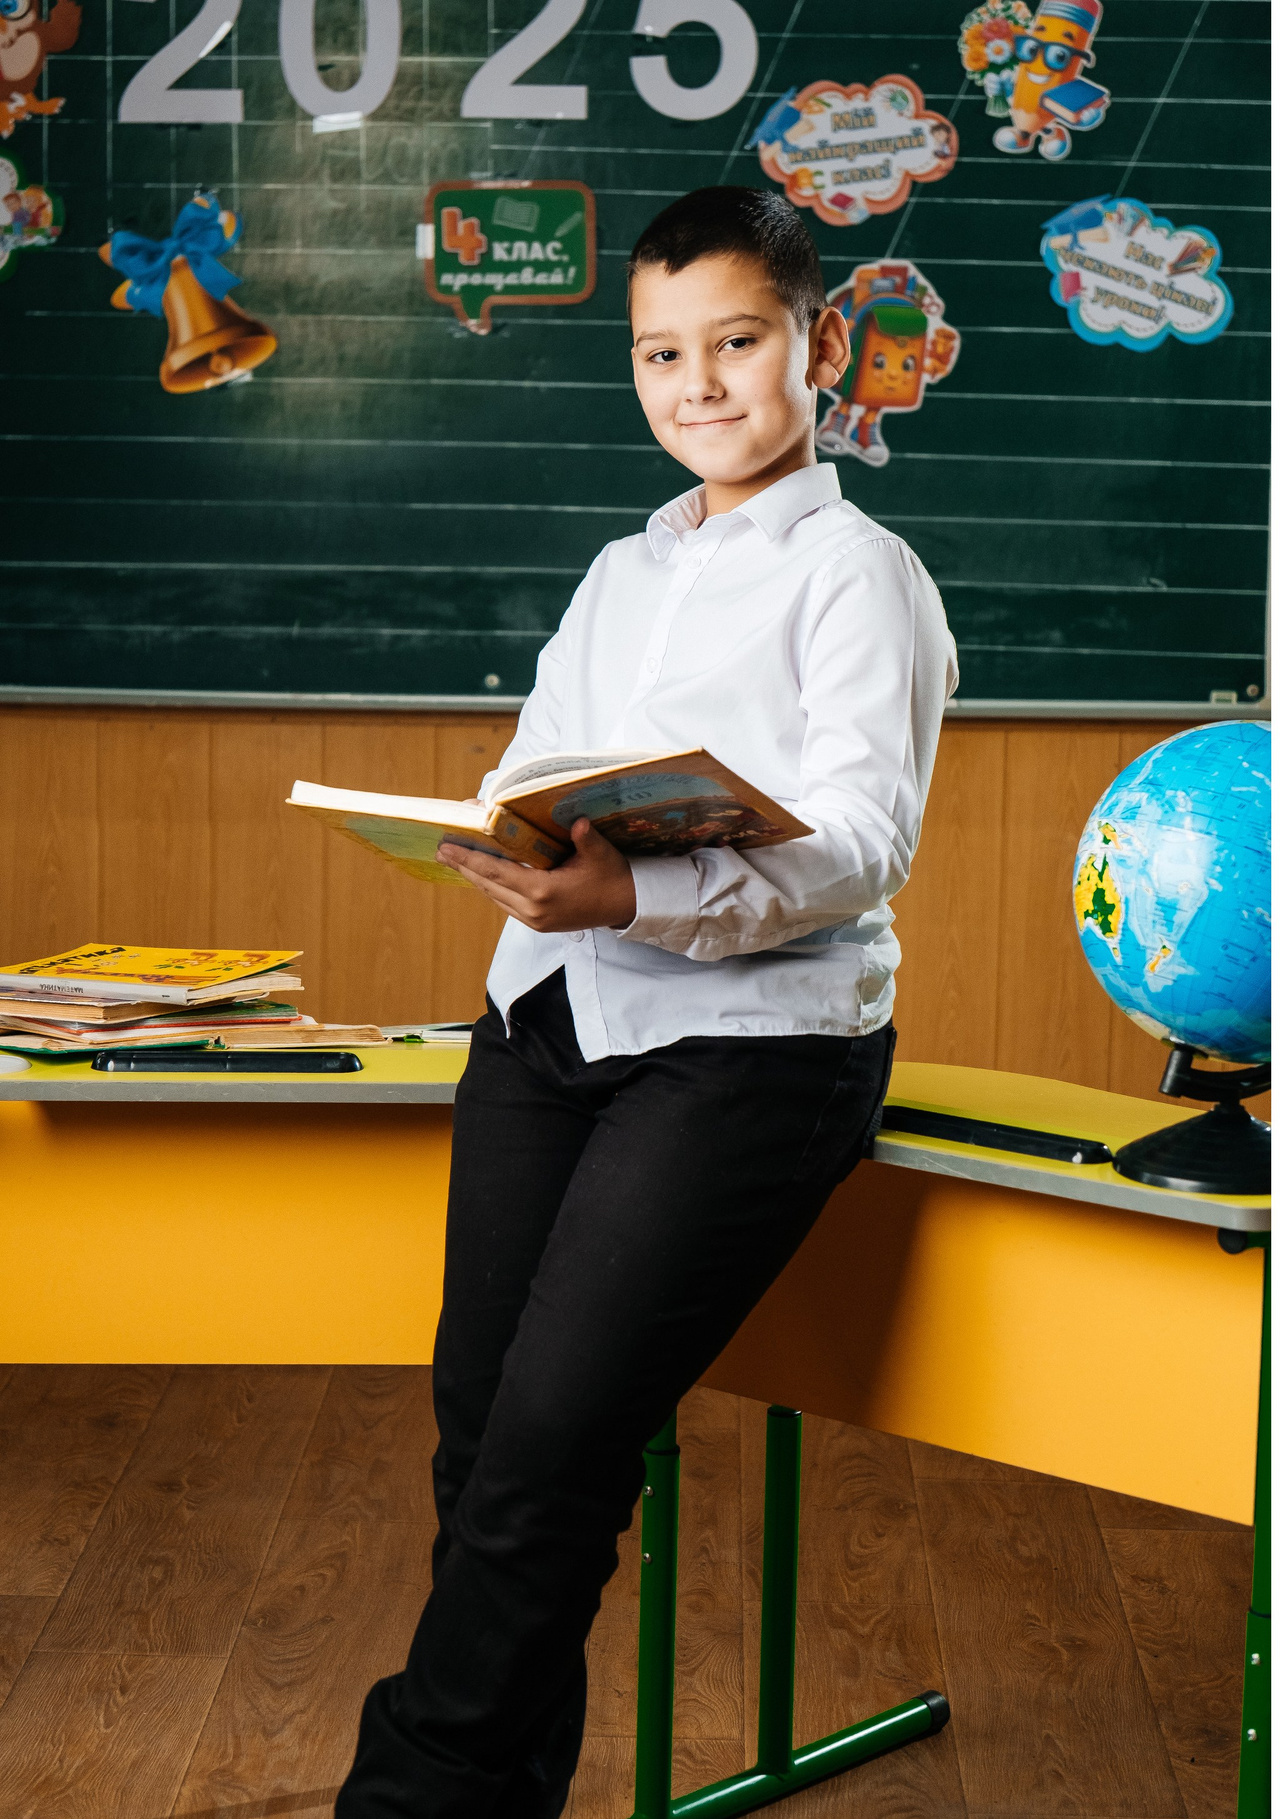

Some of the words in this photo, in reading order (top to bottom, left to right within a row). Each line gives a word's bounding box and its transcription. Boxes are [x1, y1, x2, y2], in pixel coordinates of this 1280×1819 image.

[441, 206, 488, 265] 4
[492, 241, 569, 262] КЛАС,
[439, 266, 577, 292] прощавай!
